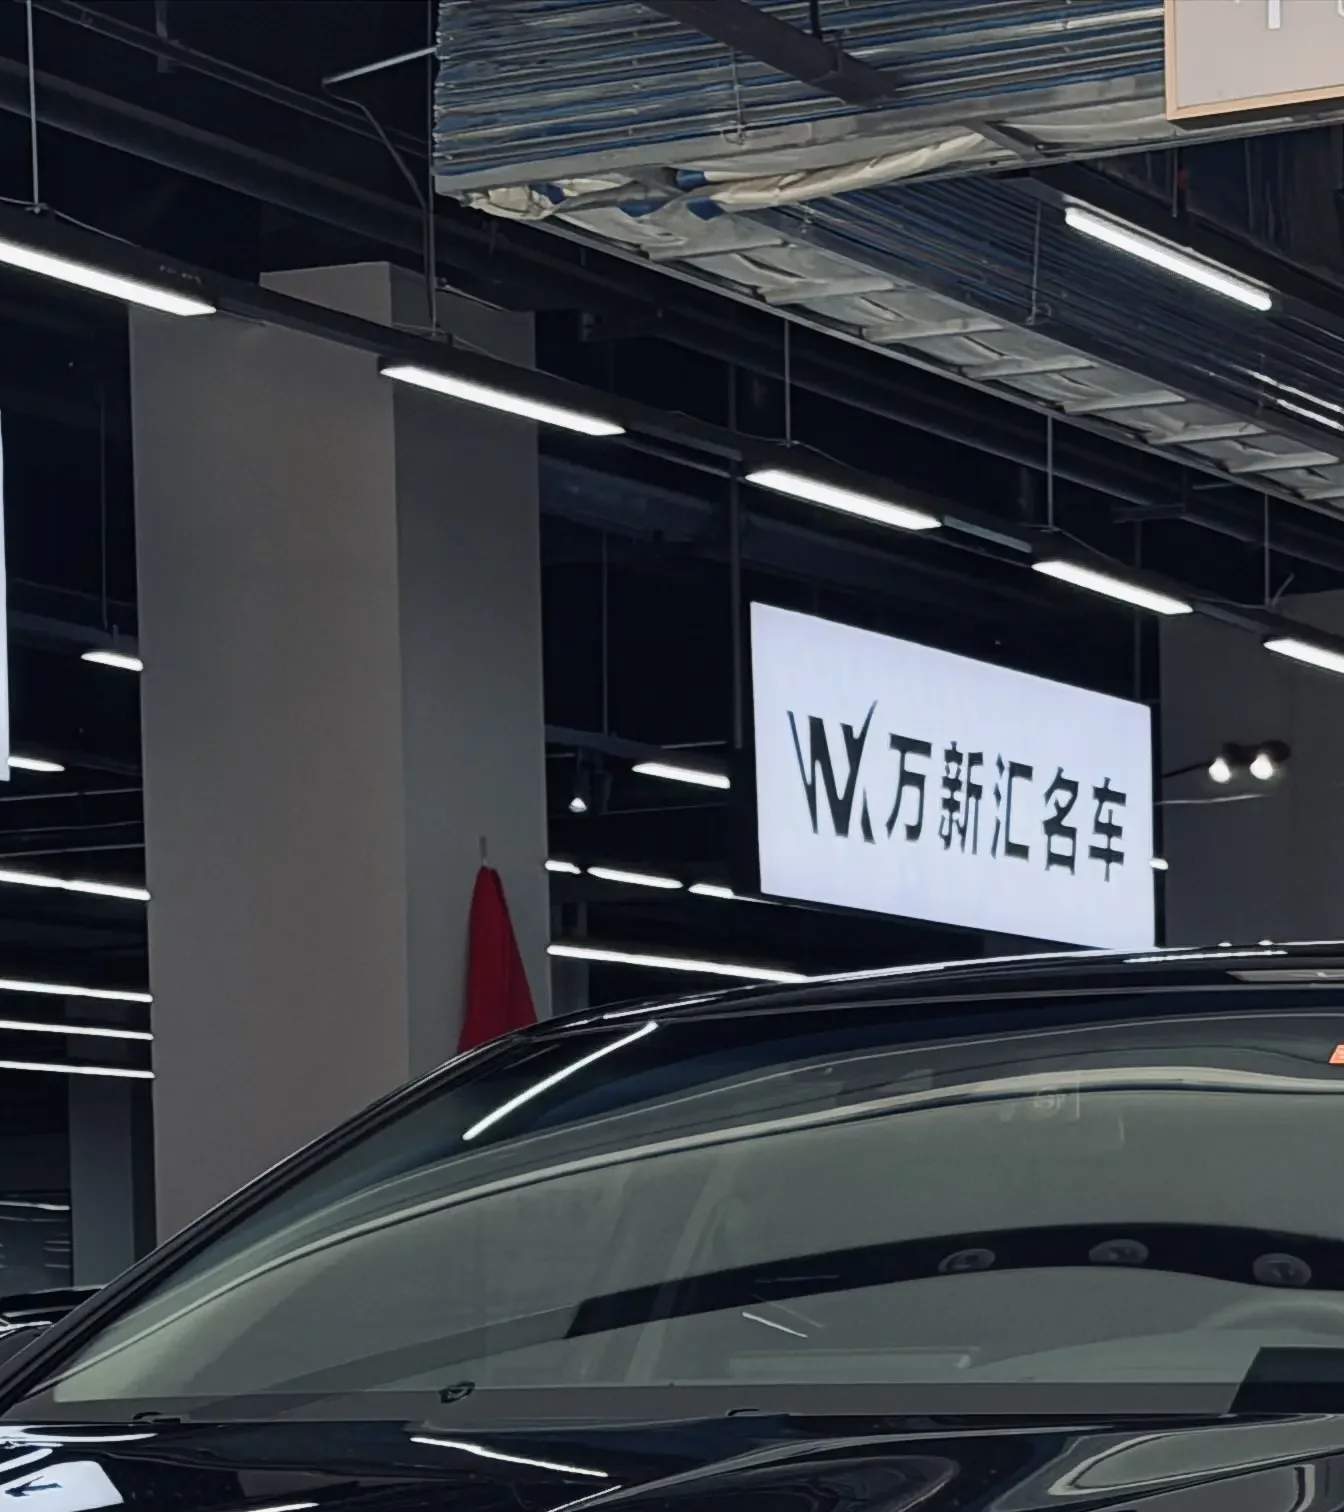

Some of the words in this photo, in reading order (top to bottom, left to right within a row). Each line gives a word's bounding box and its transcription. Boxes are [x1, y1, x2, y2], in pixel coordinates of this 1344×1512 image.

[885, 731, 1128, 883] 万新汇名车
